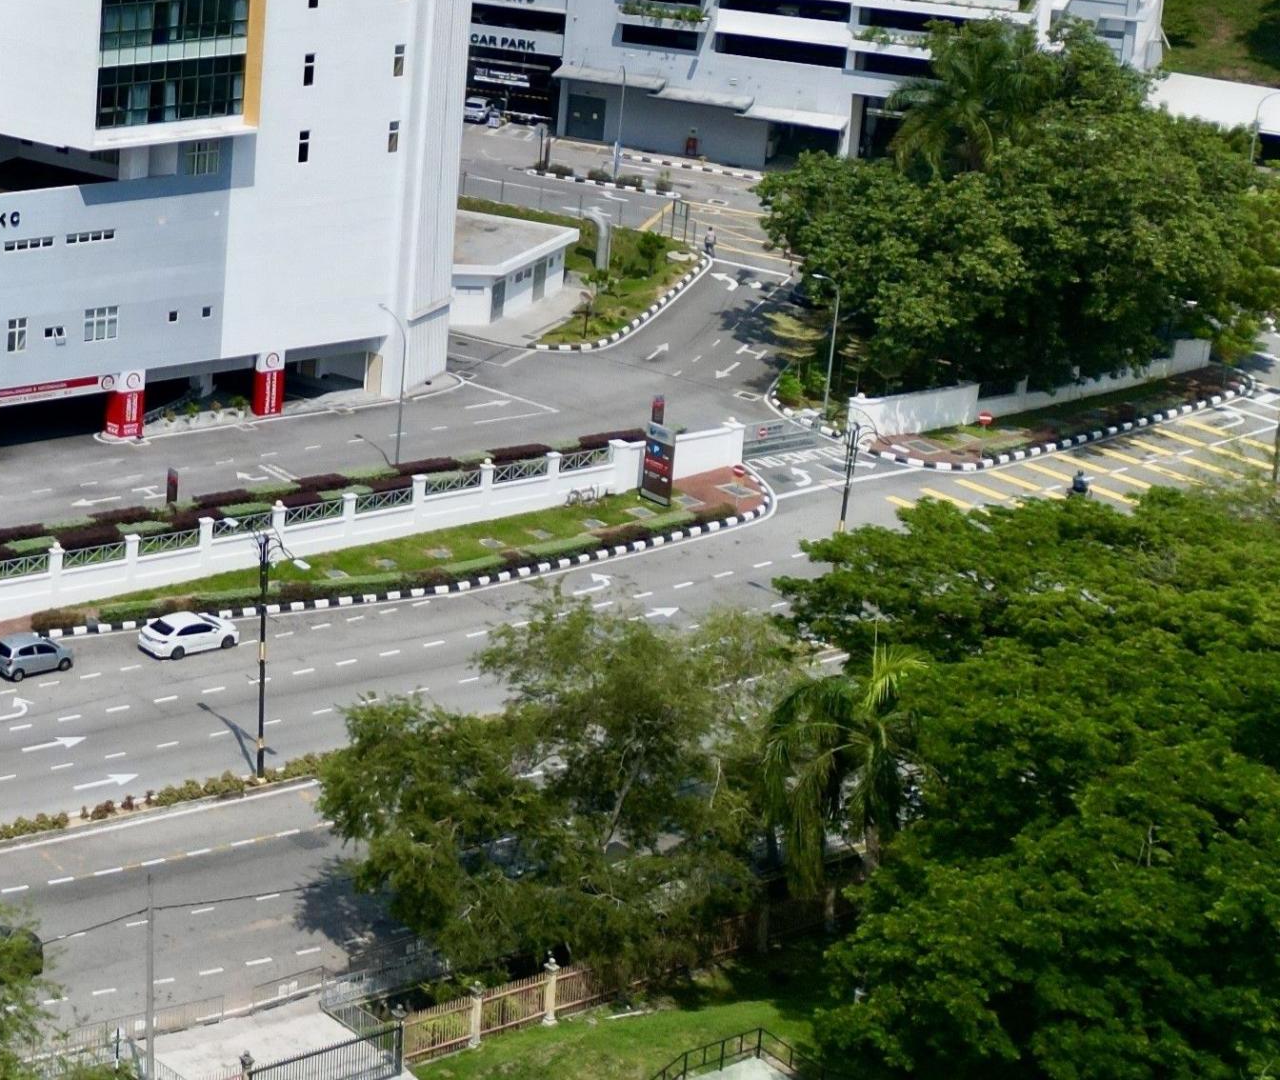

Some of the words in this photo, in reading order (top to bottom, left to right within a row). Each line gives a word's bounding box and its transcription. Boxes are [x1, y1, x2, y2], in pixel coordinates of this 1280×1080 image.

[470, 33, 497, 47] CAR
[500, 37, 536, 52] PARK
[10, 211, 20, 227] C
